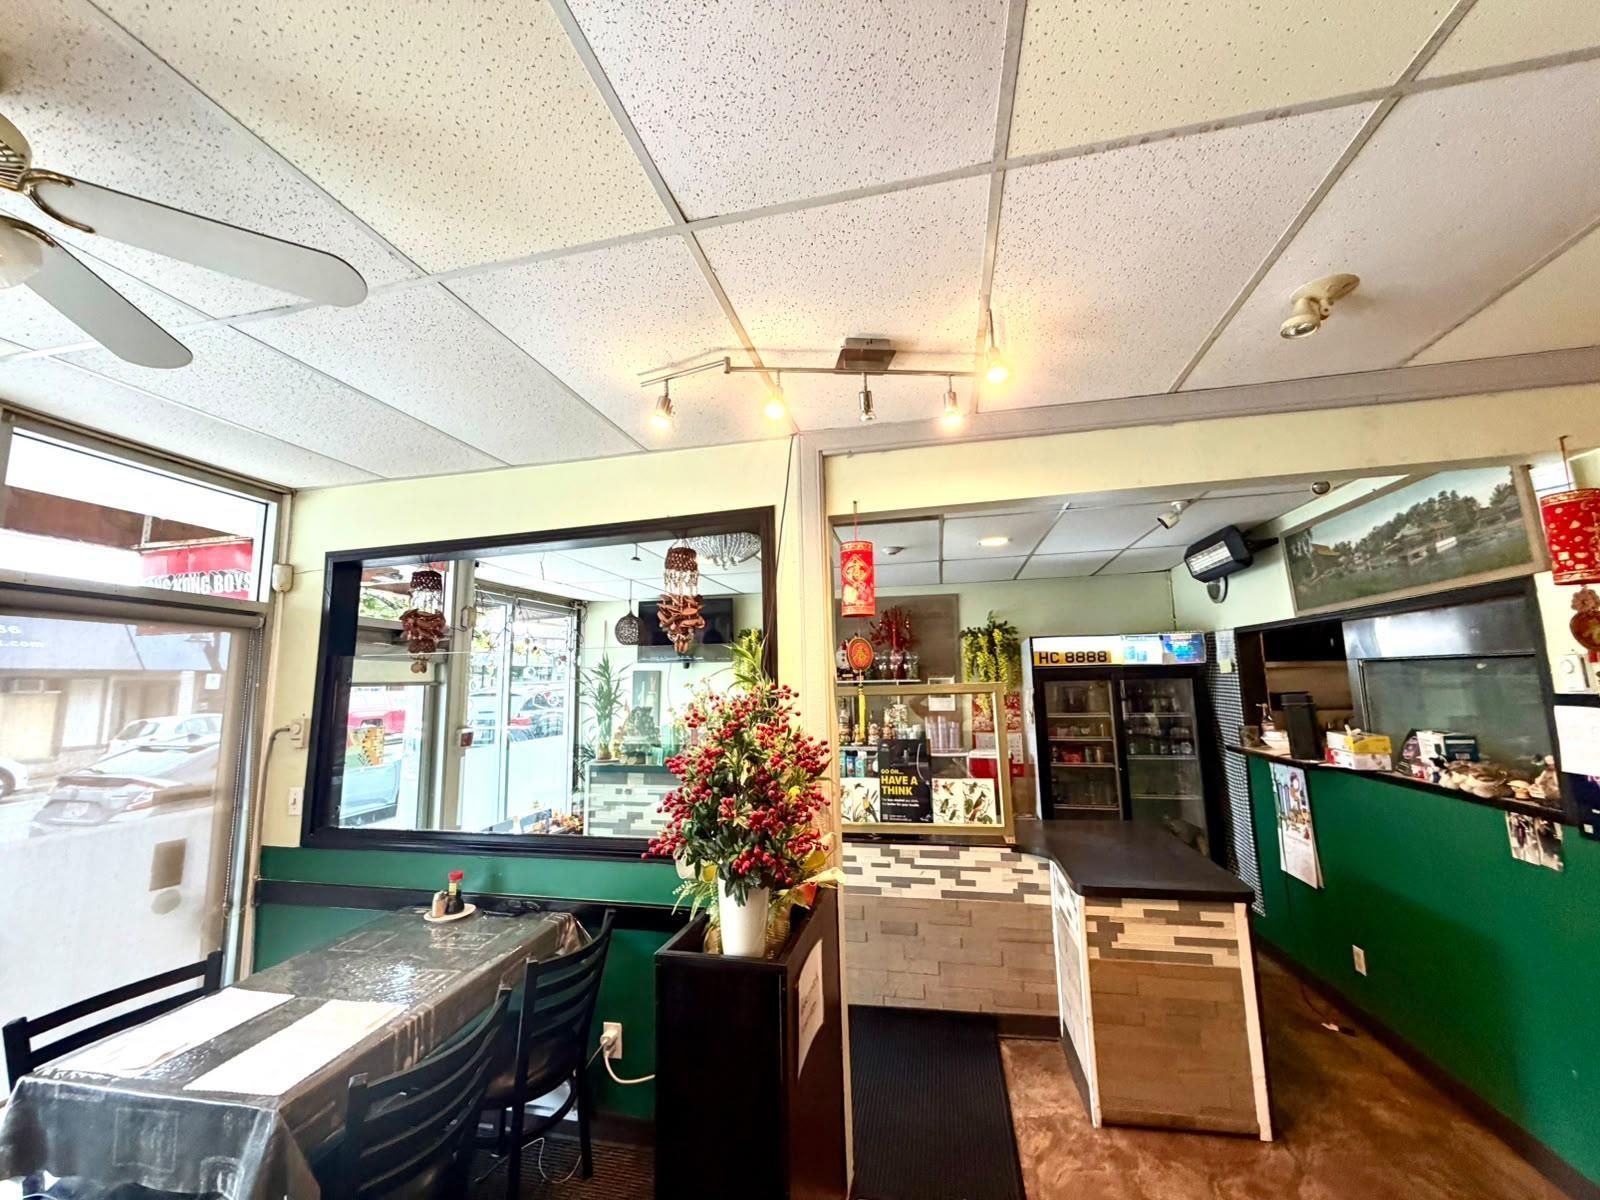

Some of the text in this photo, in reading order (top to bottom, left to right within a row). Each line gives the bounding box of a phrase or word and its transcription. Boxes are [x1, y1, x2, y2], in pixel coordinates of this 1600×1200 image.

[173, 574, 211, 595] KONG
[213, 572, 251, 593] BOYS
[1039, 651, 1108, 664] HC 8888
[881, 776, 919, 785] HAVE A
[882, 786, 913, 796] THINK
